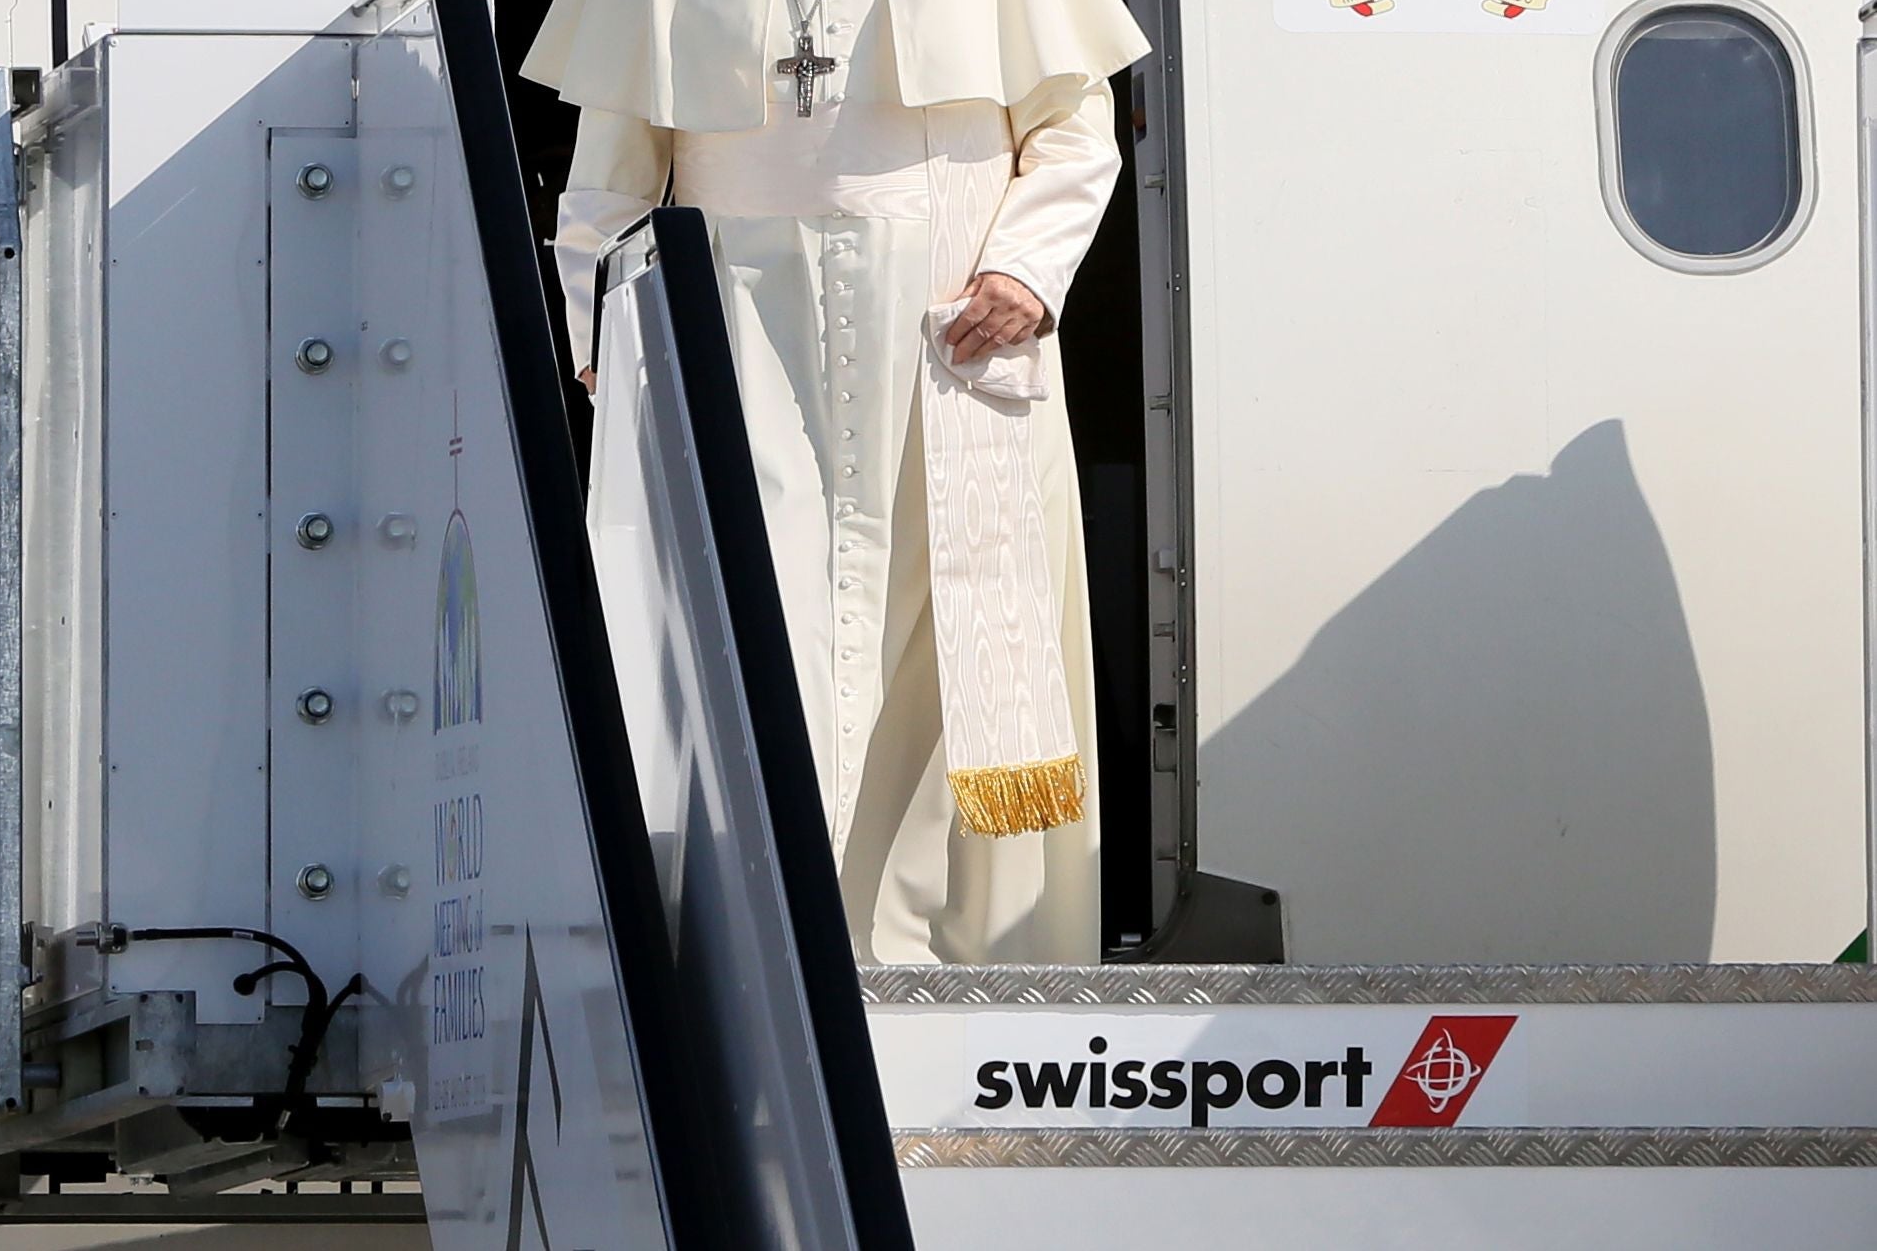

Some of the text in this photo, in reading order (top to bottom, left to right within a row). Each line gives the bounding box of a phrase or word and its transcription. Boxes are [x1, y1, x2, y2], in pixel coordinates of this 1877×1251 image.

[434, 793, 483, 887] WORLD
[434, 895, 473, 959] MEETING
[434, 967, 485, 1044] FAMILIES
[974, 1035, 1373, 1128] swissport
